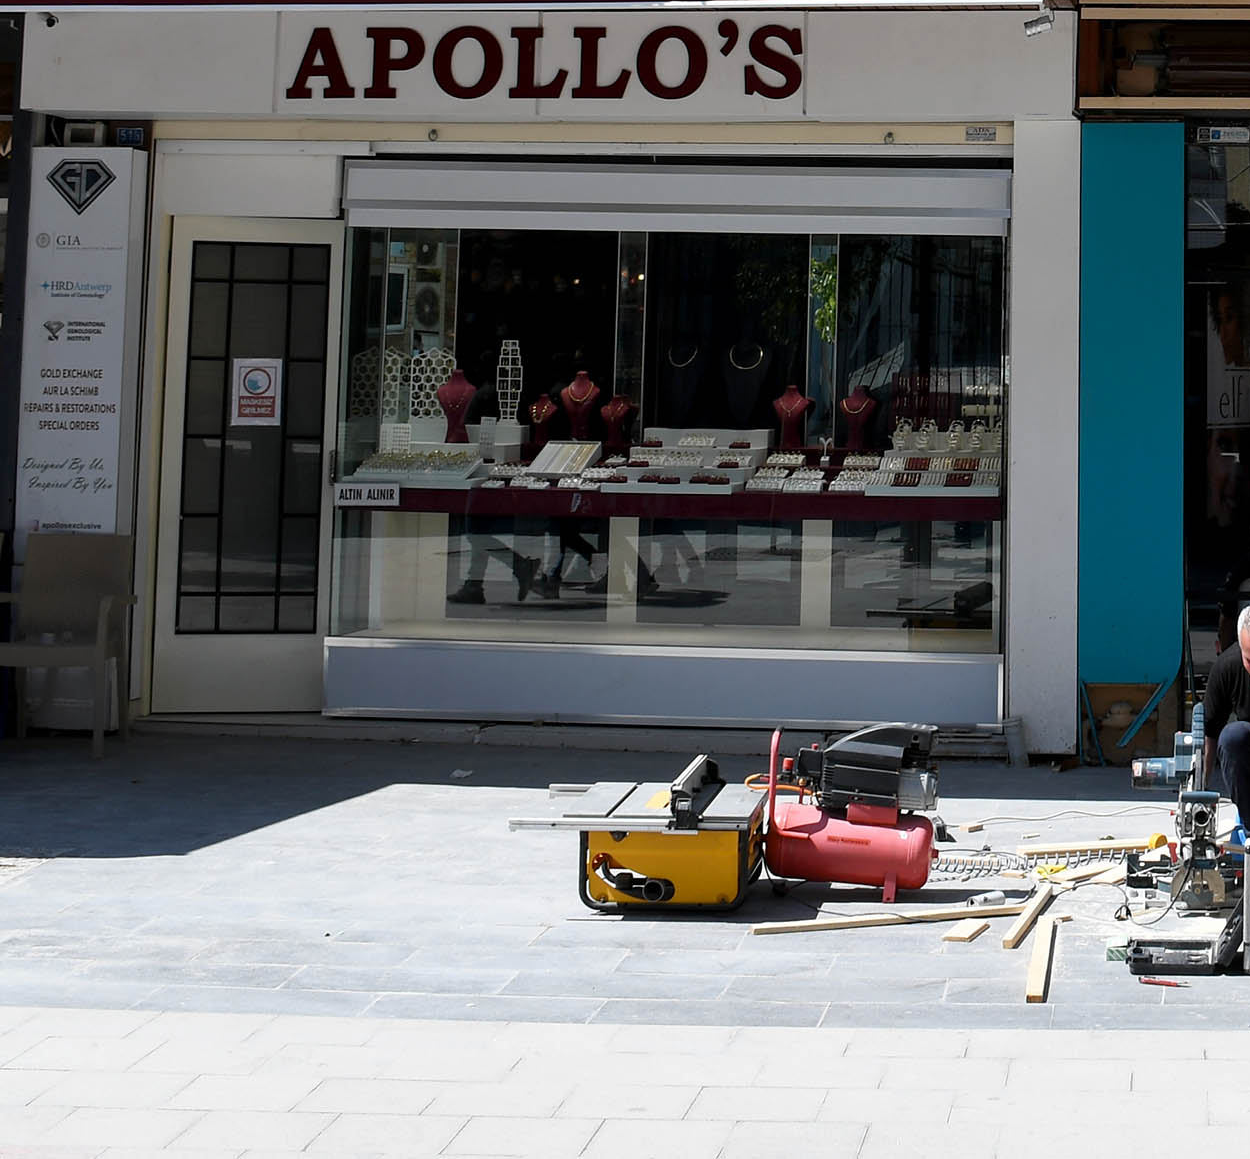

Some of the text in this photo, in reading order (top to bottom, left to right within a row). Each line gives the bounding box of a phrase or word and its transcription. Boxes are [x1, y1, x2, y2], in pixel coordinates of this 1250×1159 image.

[286, 18, 803, 100] APOLLO'S
[56, 235, 80, 246] GIA
[51, 281, 74, 290] HRD
[40, 369, 104, 379] GOLD EXCHANGE
[43, 386, 99, 396] AUR LA SCHIMB
[24, 403, 116, 414] REPAIRS & RESTORATIONS
[39, 420, 100, 431] SPECIAL ORDERS
[22, 457, 69, 473] Designed
[68, 457, 85, 474] By
[28, 476, 112, 494] Inspired By You
[339, 489, 395, 500] ALTIN ALINIR
[42, 522, 102, 530] apollosexclusive
